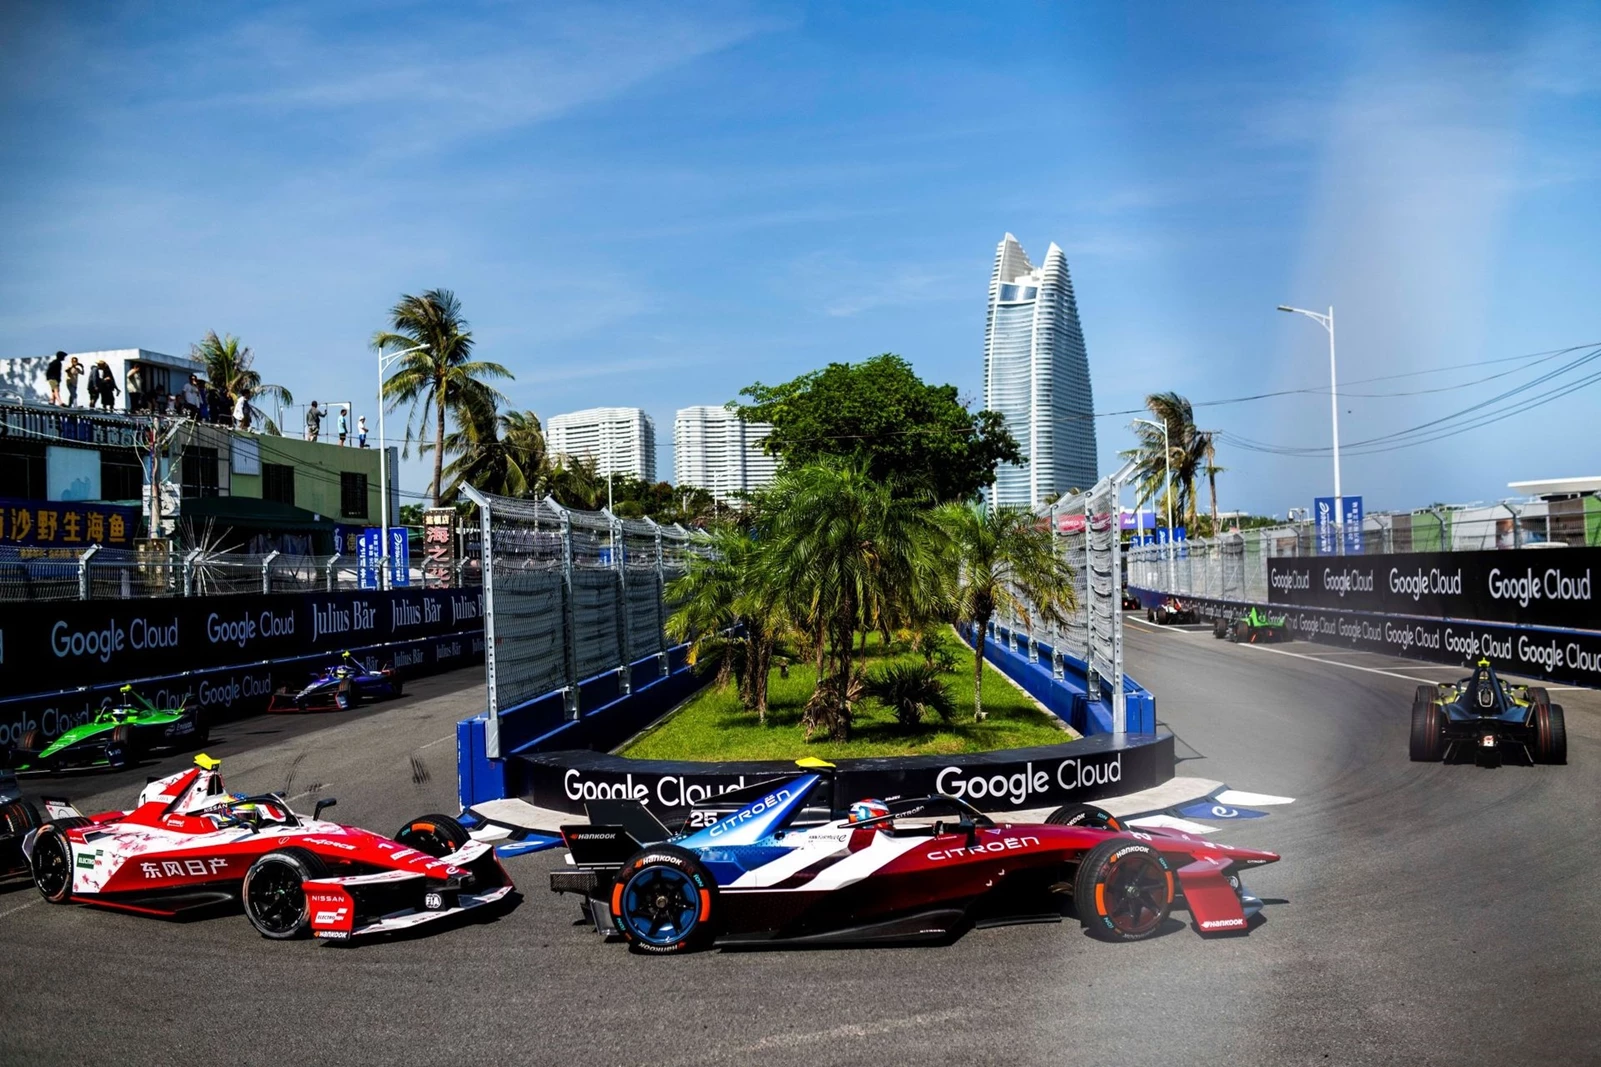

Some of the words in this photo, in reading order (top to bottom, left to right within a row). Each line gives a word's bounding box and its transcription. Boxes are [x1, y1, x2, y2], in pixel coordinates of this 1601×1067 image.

[0, 508, 126, 542] 沙野生海鱼
[1271, 568, 1292, 594] Google
[1293, 570, 1309, 589] Cloud
[1324, 568, 1350, 596] Google
[1351, 569, 1373, 591] Cloud
[1390, 568, 1429, 600] Google
[1430, 568, 1461, 595] Cloud
[1489, 568, 1541, 607] Google
[1544, 568, 1591, 600] Cloud
[312, 603, 350, 642] Julius
[353, 601, 376, 631] Bär
[391, 599, 421, 633] Julius
[423, 597, 441, 623] Bär
[451, 595, 476, 626] Julius
[1300, 614, 1319, 636] Google
[1320, 617, 1336, 634] Cloud
[52, 619, 124, 662] Google
[130, 617, 178, 649] Cloud
[207, 611, 256, 647] Google
[260, 610, 295, 638] Cloud
[1339, 617, 1361, 642] Google
[1362, 621, 1381, 640] Cloud
[1385, 622, 1413, 650] Google
[1415, 626, 1439, 649] Cloud
[1444, 628, 1480, 660] Google
[1481, 633, 1512, 659] Cloud
[394, 651, 412, 668] Julius
[412, 649, 424, 663] Bär
[1518, 635, 1564, 672] Google
[200, 680, 240, 708] Google
[242, 675, 272, 697] Cloud
[0, 711, 36, 745] ogle
[936, 762, 1049, 805] Google
[1057, 753, 1121, 790] Cloud
[203, 803, 228, 813] NISSAN
[690, 811, 717, 828] 25
[710, 789, 791, 838] CITROËN
[927, 836, 1040, 860] CITROËN
[140, 857, 228, 879] 东风日产
[426, 896, 440, 906] FIA
